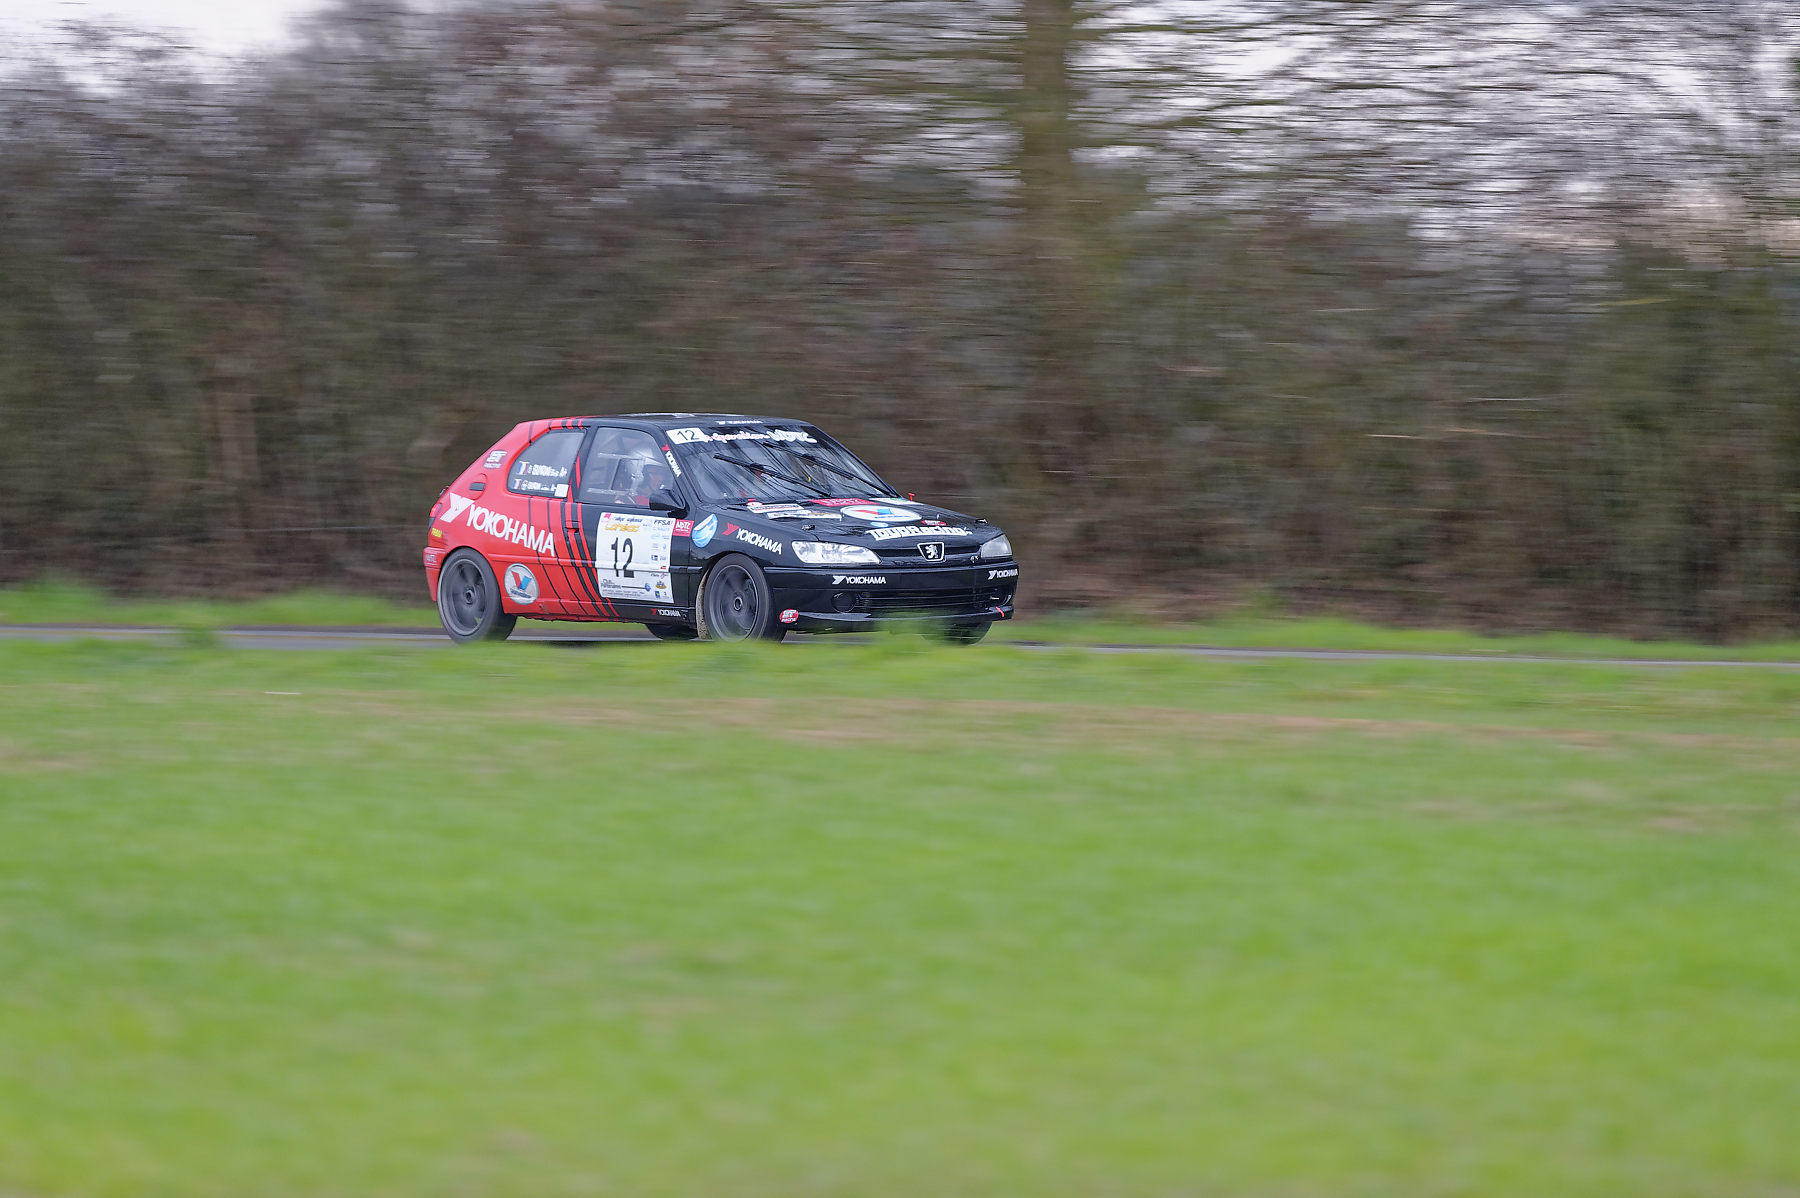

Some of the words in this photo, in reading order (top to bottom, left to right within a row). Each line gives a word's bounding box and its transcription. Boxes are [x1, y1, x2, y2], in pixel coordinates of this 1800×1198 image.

[677, 430, 700, 441] 12
[466, 504, 555, 557] YOKOHAMA
[736, 528, 782, 555] YOKOHAMA
[611, 537, 634, 578] 12
[845, 576, 887, 584] YOKOHAMA
